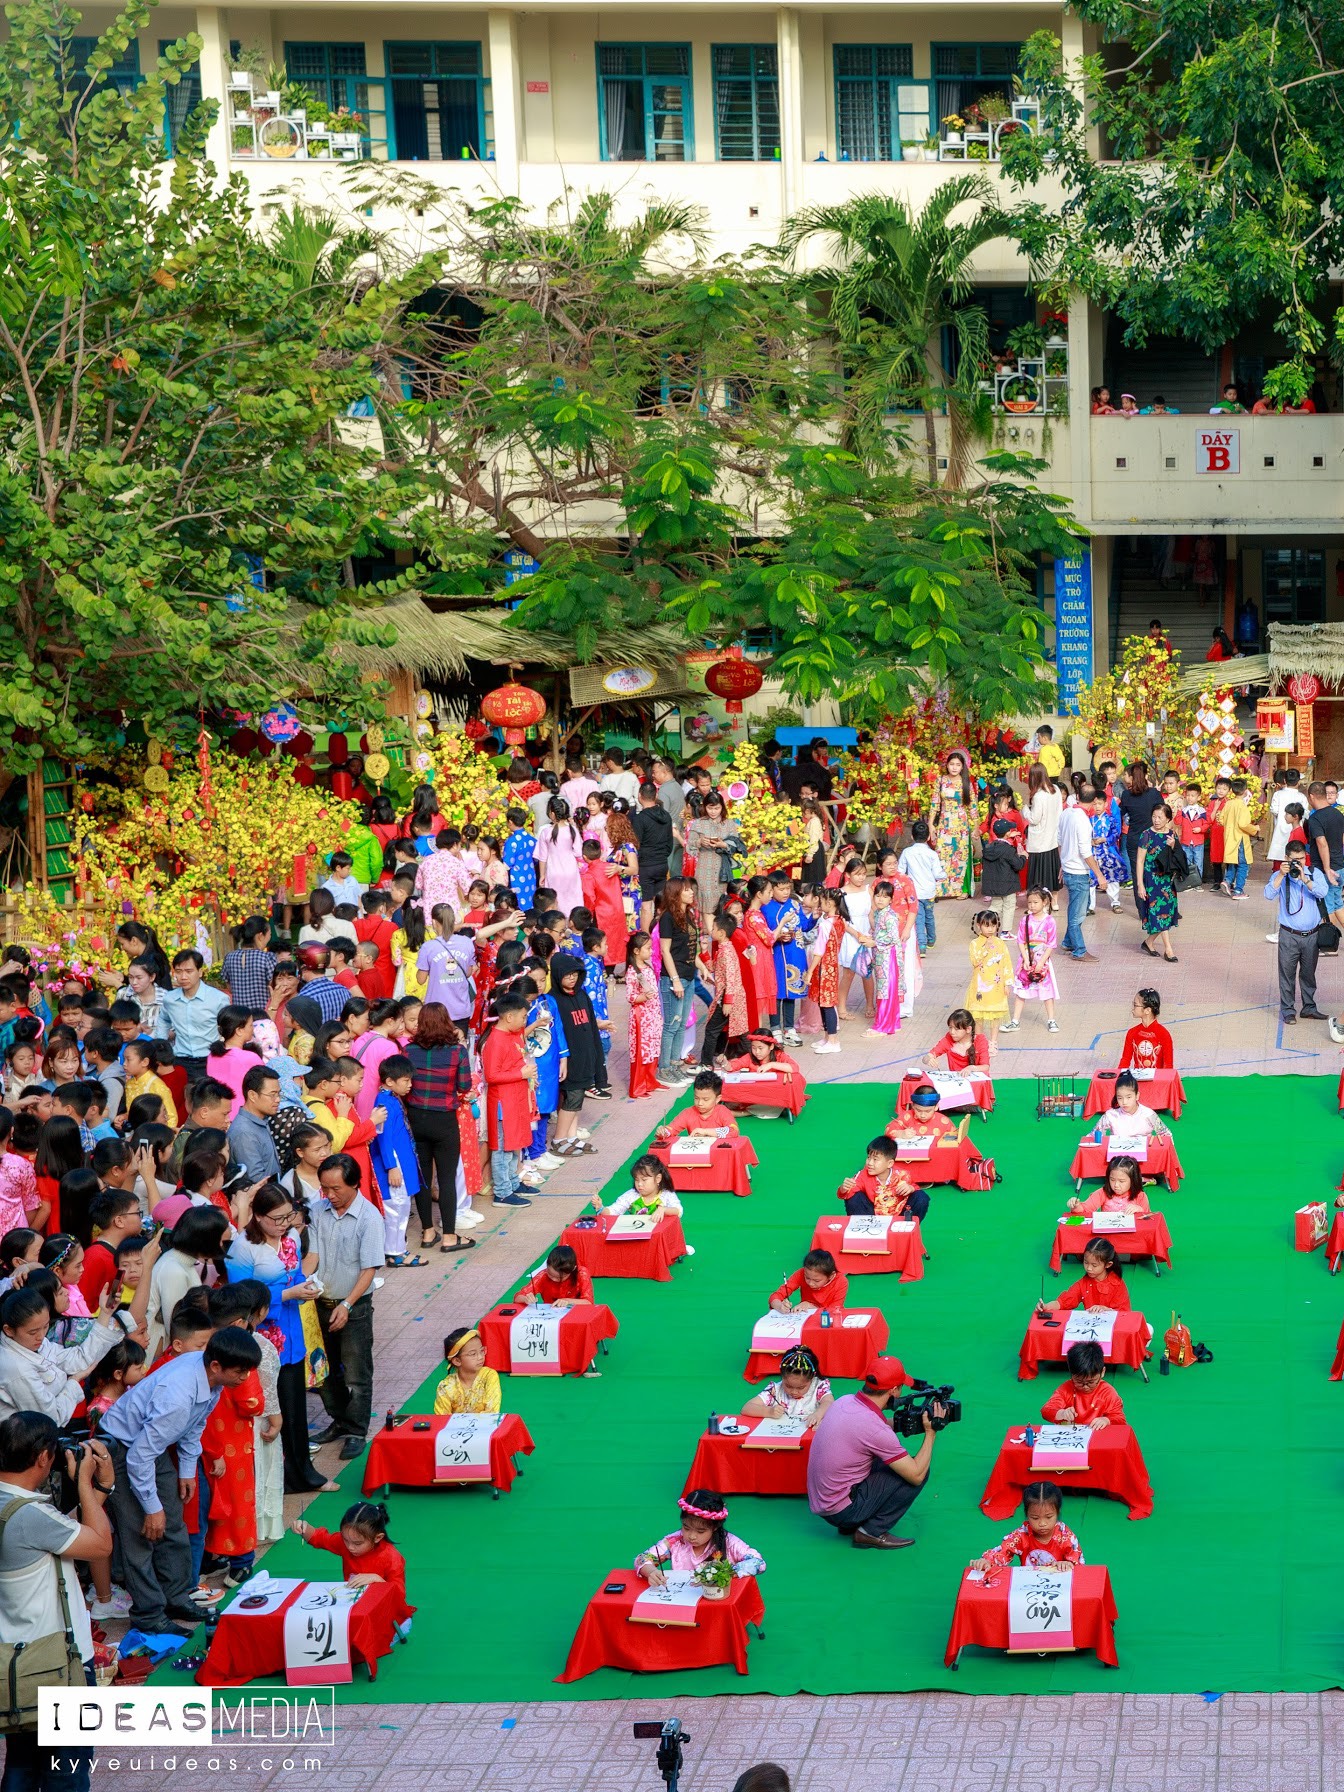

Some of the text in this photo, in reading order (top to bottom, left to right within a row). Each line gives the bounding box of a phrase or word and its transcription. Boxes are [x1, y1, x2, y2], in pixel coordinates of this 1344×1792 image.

[1201, 431, 1234, 446] DÃY
[1206, 446, 1231, 471] B
[1066, 586, 1082, 597] TRÒ
[1061, 615, 1087, 624] NGOAN
[1061, 643, 1088, 651] KHANG
[1062, 656, 1088, 665] TRANG
[432, 949, 469, 963] NEW YORK
[571, 1008, 590, 1026] TEAM
